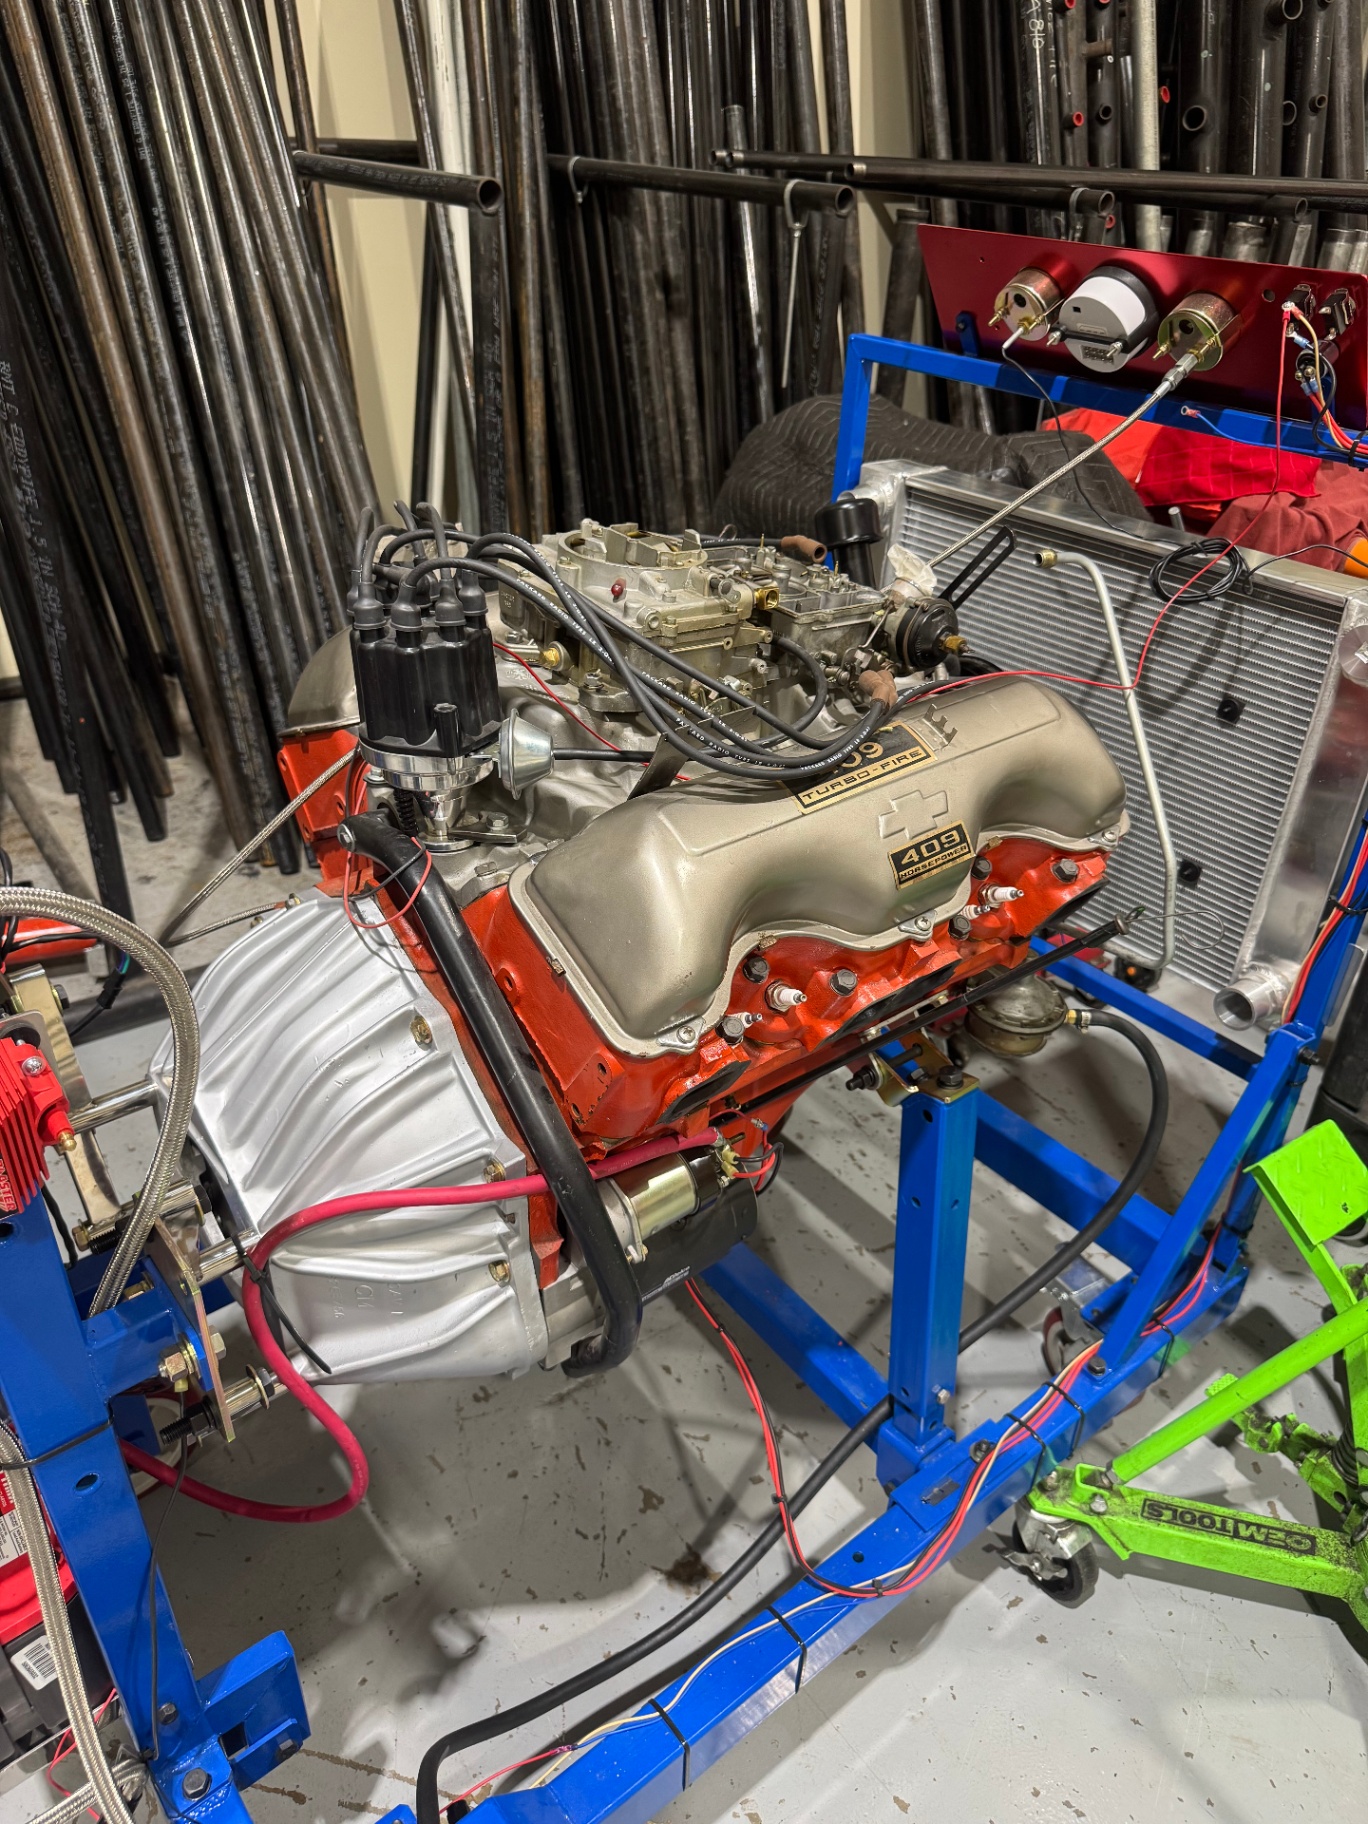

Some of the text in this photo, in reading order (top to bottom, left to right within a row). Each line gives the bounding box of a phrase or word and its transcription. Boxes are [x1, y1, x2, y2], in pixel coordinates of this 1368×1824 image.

[802, 749, 922, 800] TURBO-FIRE
[900, 844, 967, 878] HORSEPOWER
[901, 830, 961, 866] 409
